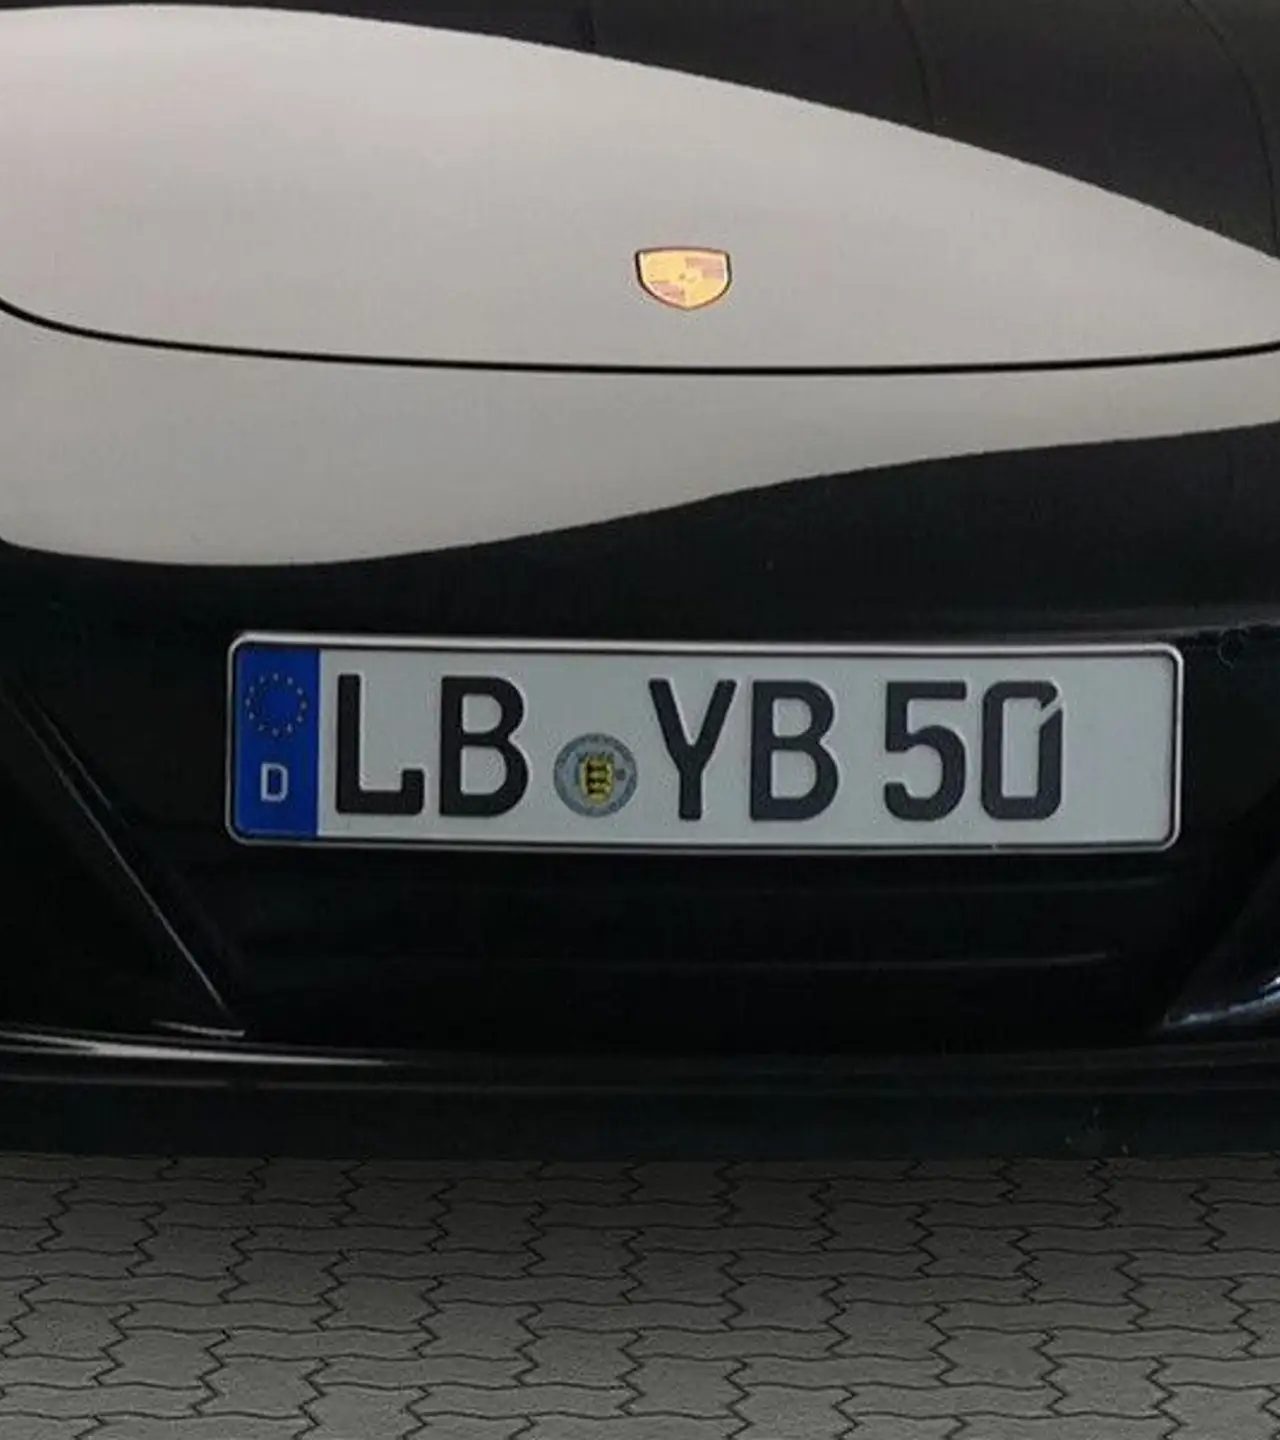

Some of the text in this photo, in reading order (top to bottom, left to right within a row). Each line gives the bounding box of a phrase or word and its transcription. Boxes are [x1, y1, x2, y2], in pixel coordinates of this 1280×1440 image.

[260, 762, 288, 802] D
[336, 673, 528, 819] LB
[647, 678, 837, 822] YB
[883, 680, 1063, 821] 50
